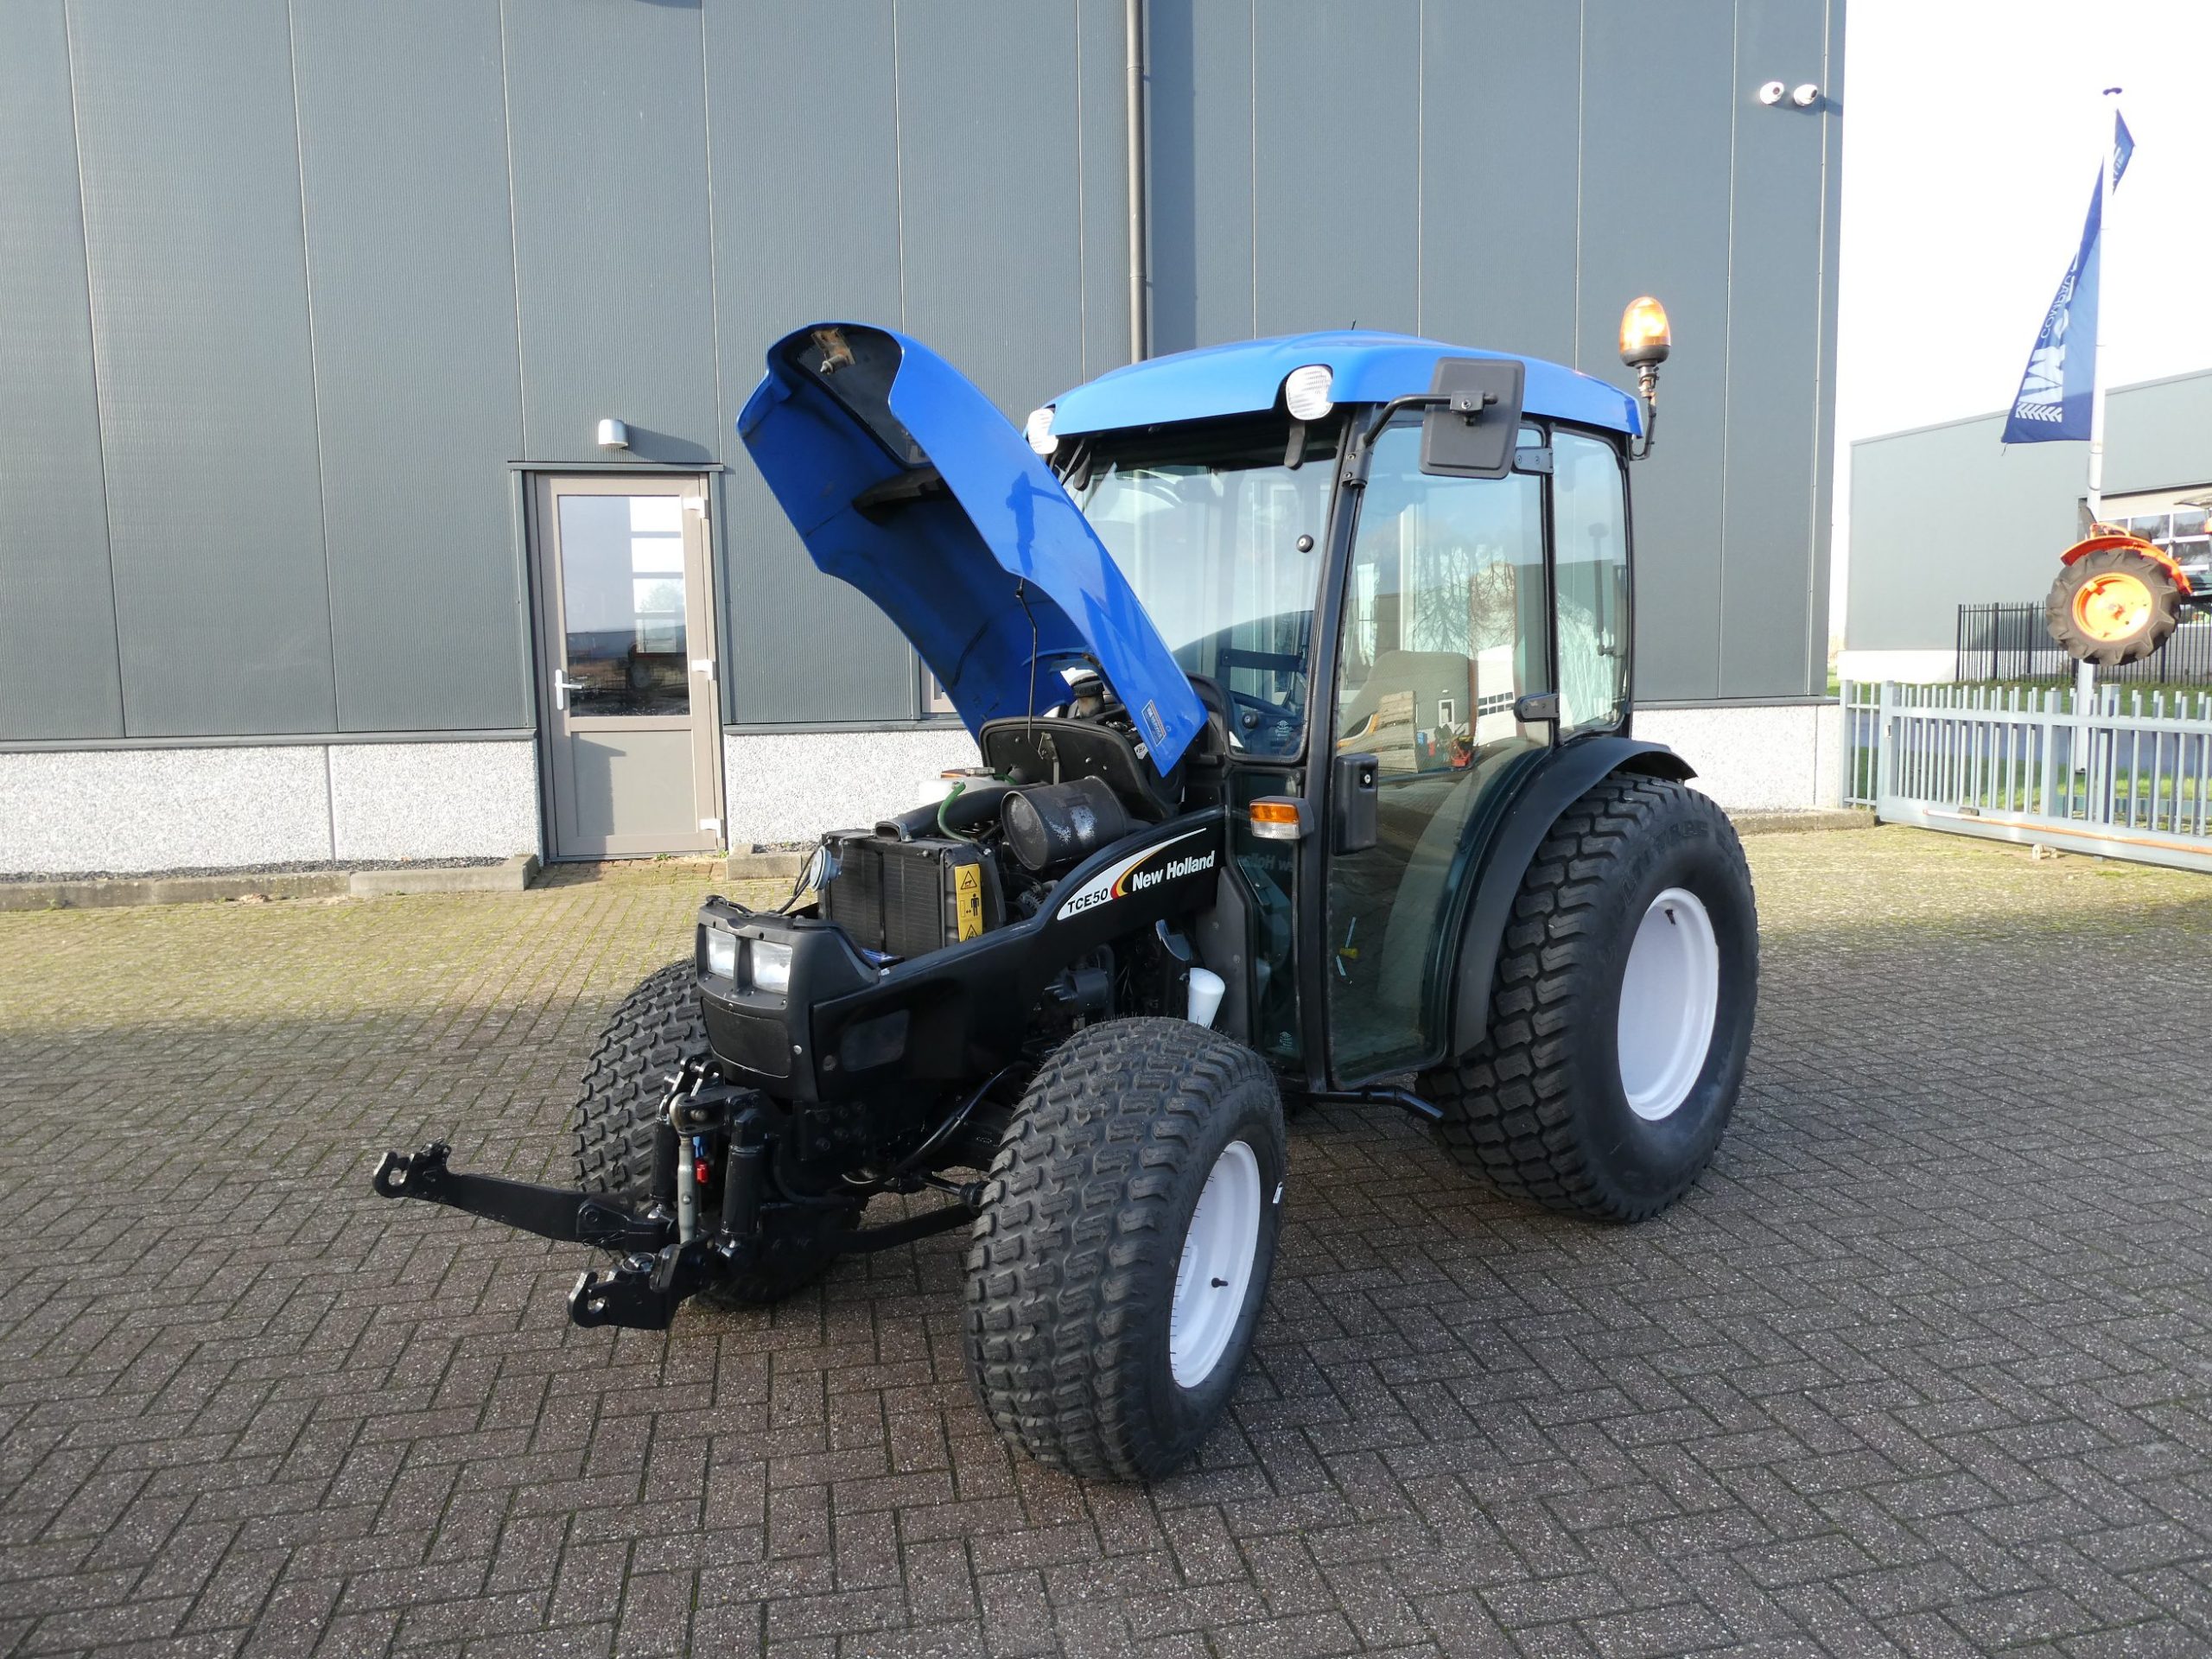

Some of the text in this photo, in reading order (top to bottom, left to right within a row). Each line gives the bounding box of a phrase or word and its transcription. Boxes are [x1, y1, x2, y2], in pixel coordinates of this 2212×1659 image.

[1133, 850, 1216, 892] New Holland
[1067, 888, 1109, 913] TCE50
